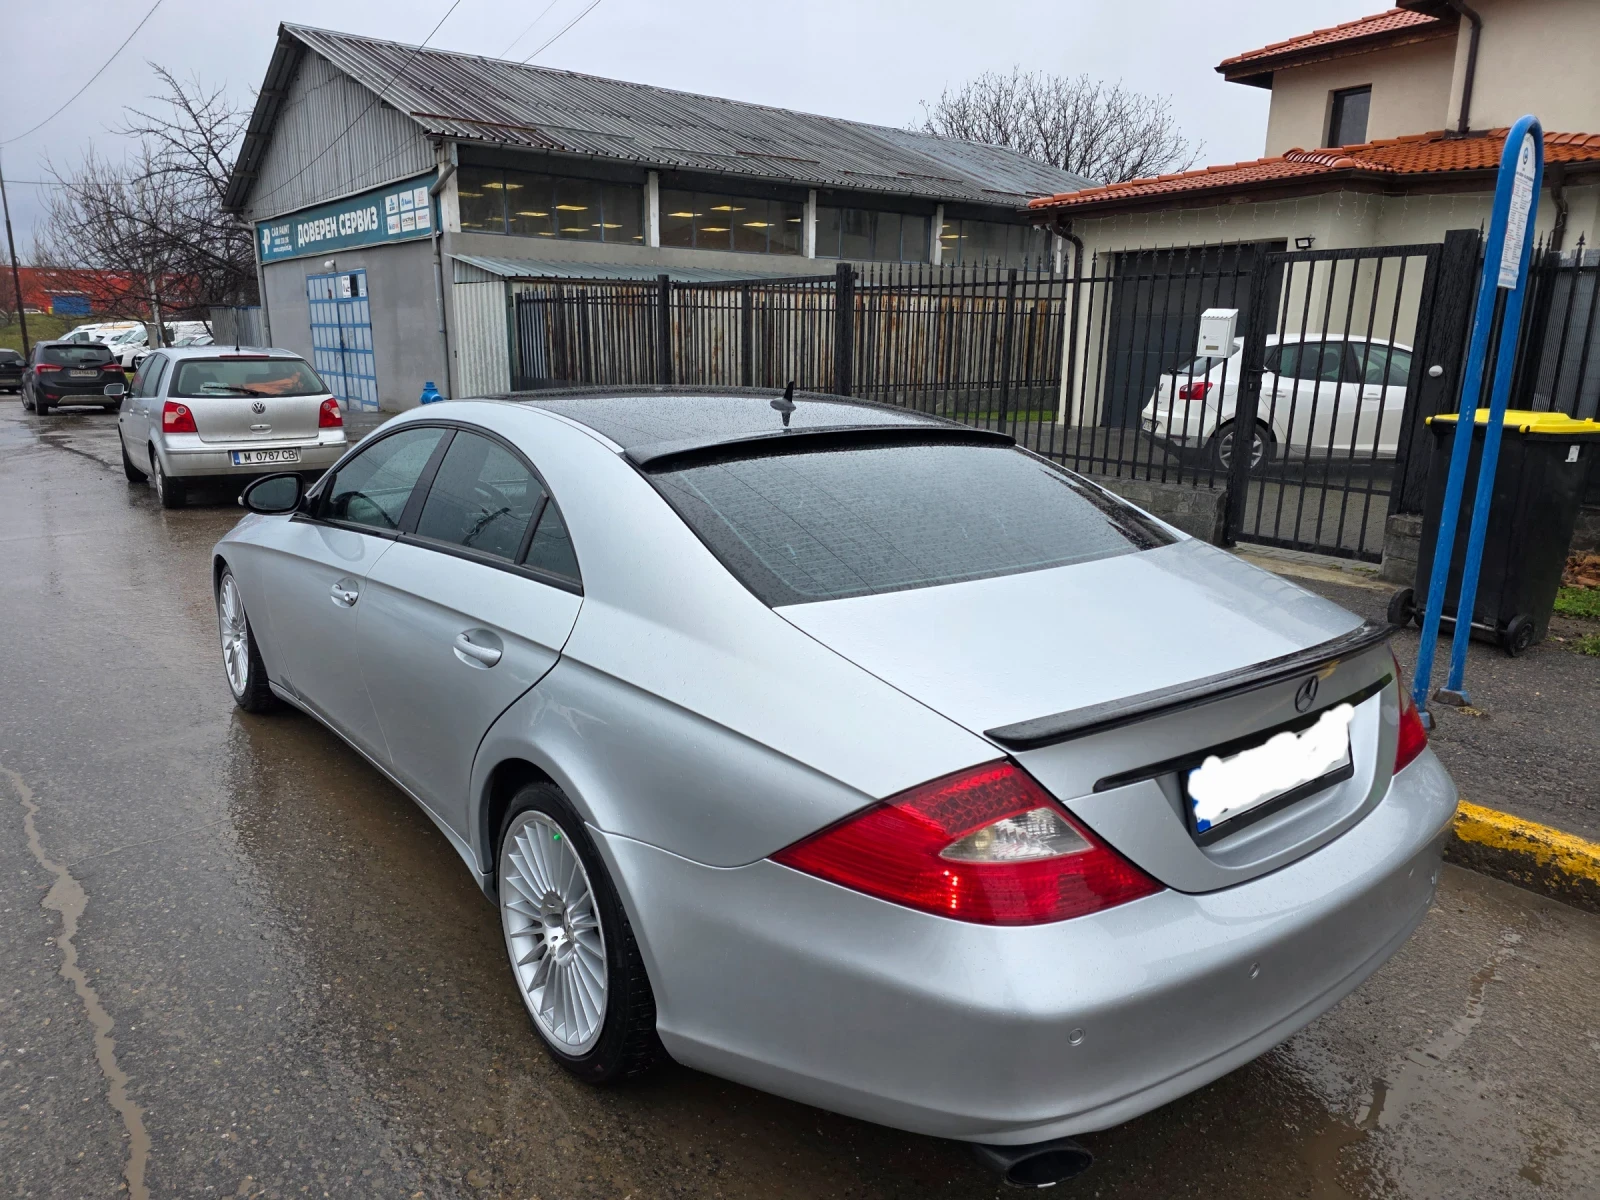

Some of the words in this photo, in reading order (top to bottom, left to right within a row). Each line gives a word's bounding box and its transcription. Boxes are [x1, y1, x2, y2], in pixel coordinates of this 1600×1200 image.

[298, 216, 337, 247] ДОВЕРЕН
[339, 206, 378, 235] СЕРВИЗ
[244, 453, 251, 462] M
[256, 451, 280, 461] 0787
[282, 450, 295, 460] CB
